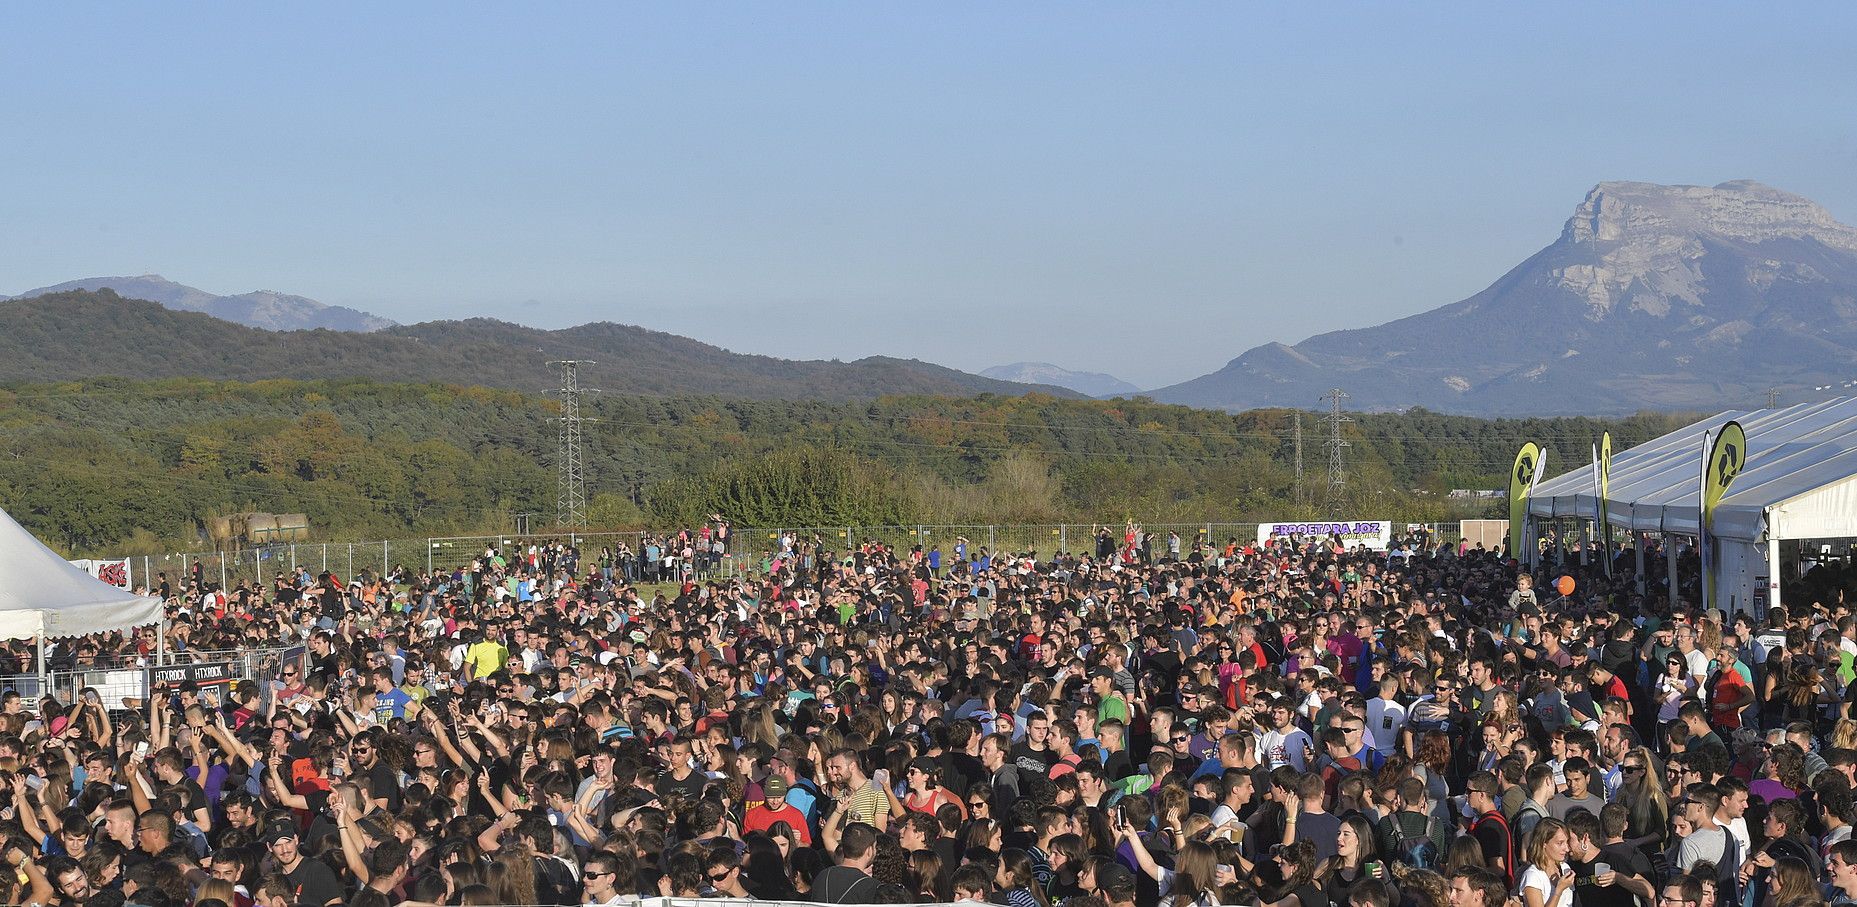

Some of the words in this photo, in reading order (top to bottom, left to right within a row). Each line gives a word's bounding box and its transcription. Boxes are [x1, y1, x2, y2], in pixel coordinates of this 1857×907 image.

[1353, 523, 1380, 534] JOZ
[155, 669, 186, 682] HTXROCK
[195, 666, 222, 679] HTXROCK
